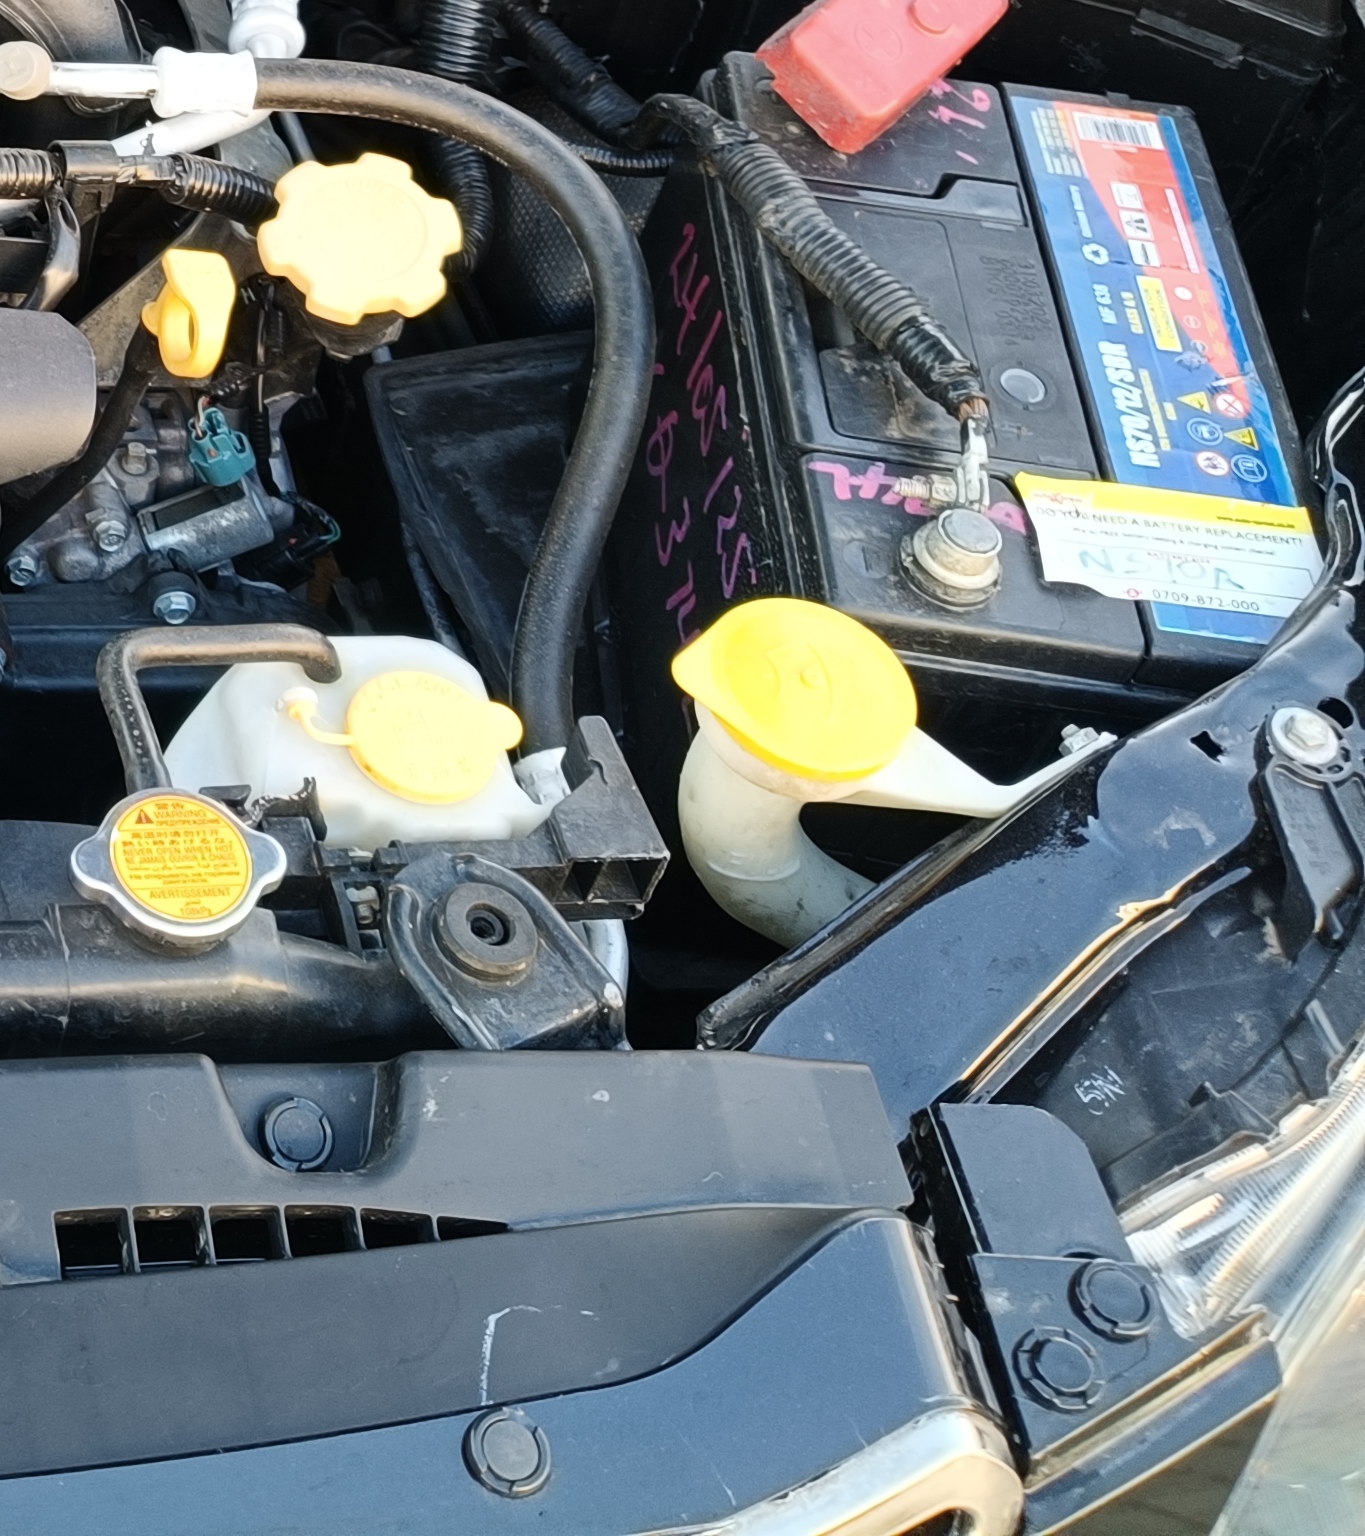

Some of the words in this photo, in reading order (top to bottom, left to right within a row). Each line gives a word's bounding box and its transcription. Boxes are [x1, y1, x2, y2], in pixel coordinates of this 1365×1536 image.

[1035, 506, 1056, 517] DO
[1058, 509, 1089, 521] YOU
[1093, 512, 1127, 525] NEED
[1130, 515, 1140, 527] A
[1143, 518, 1201, 534] BATTERY
[1152, 588, 1261, 613] 0709-872-000
[154, 809, 207, 819] WARNING
[123, 847, 153, 856] NEVER
[156, 847, 181, 855] OPEN
[184, 845, 212, 855] WHEN
[149, 887, 231, 900] AVERTISSEMENT
